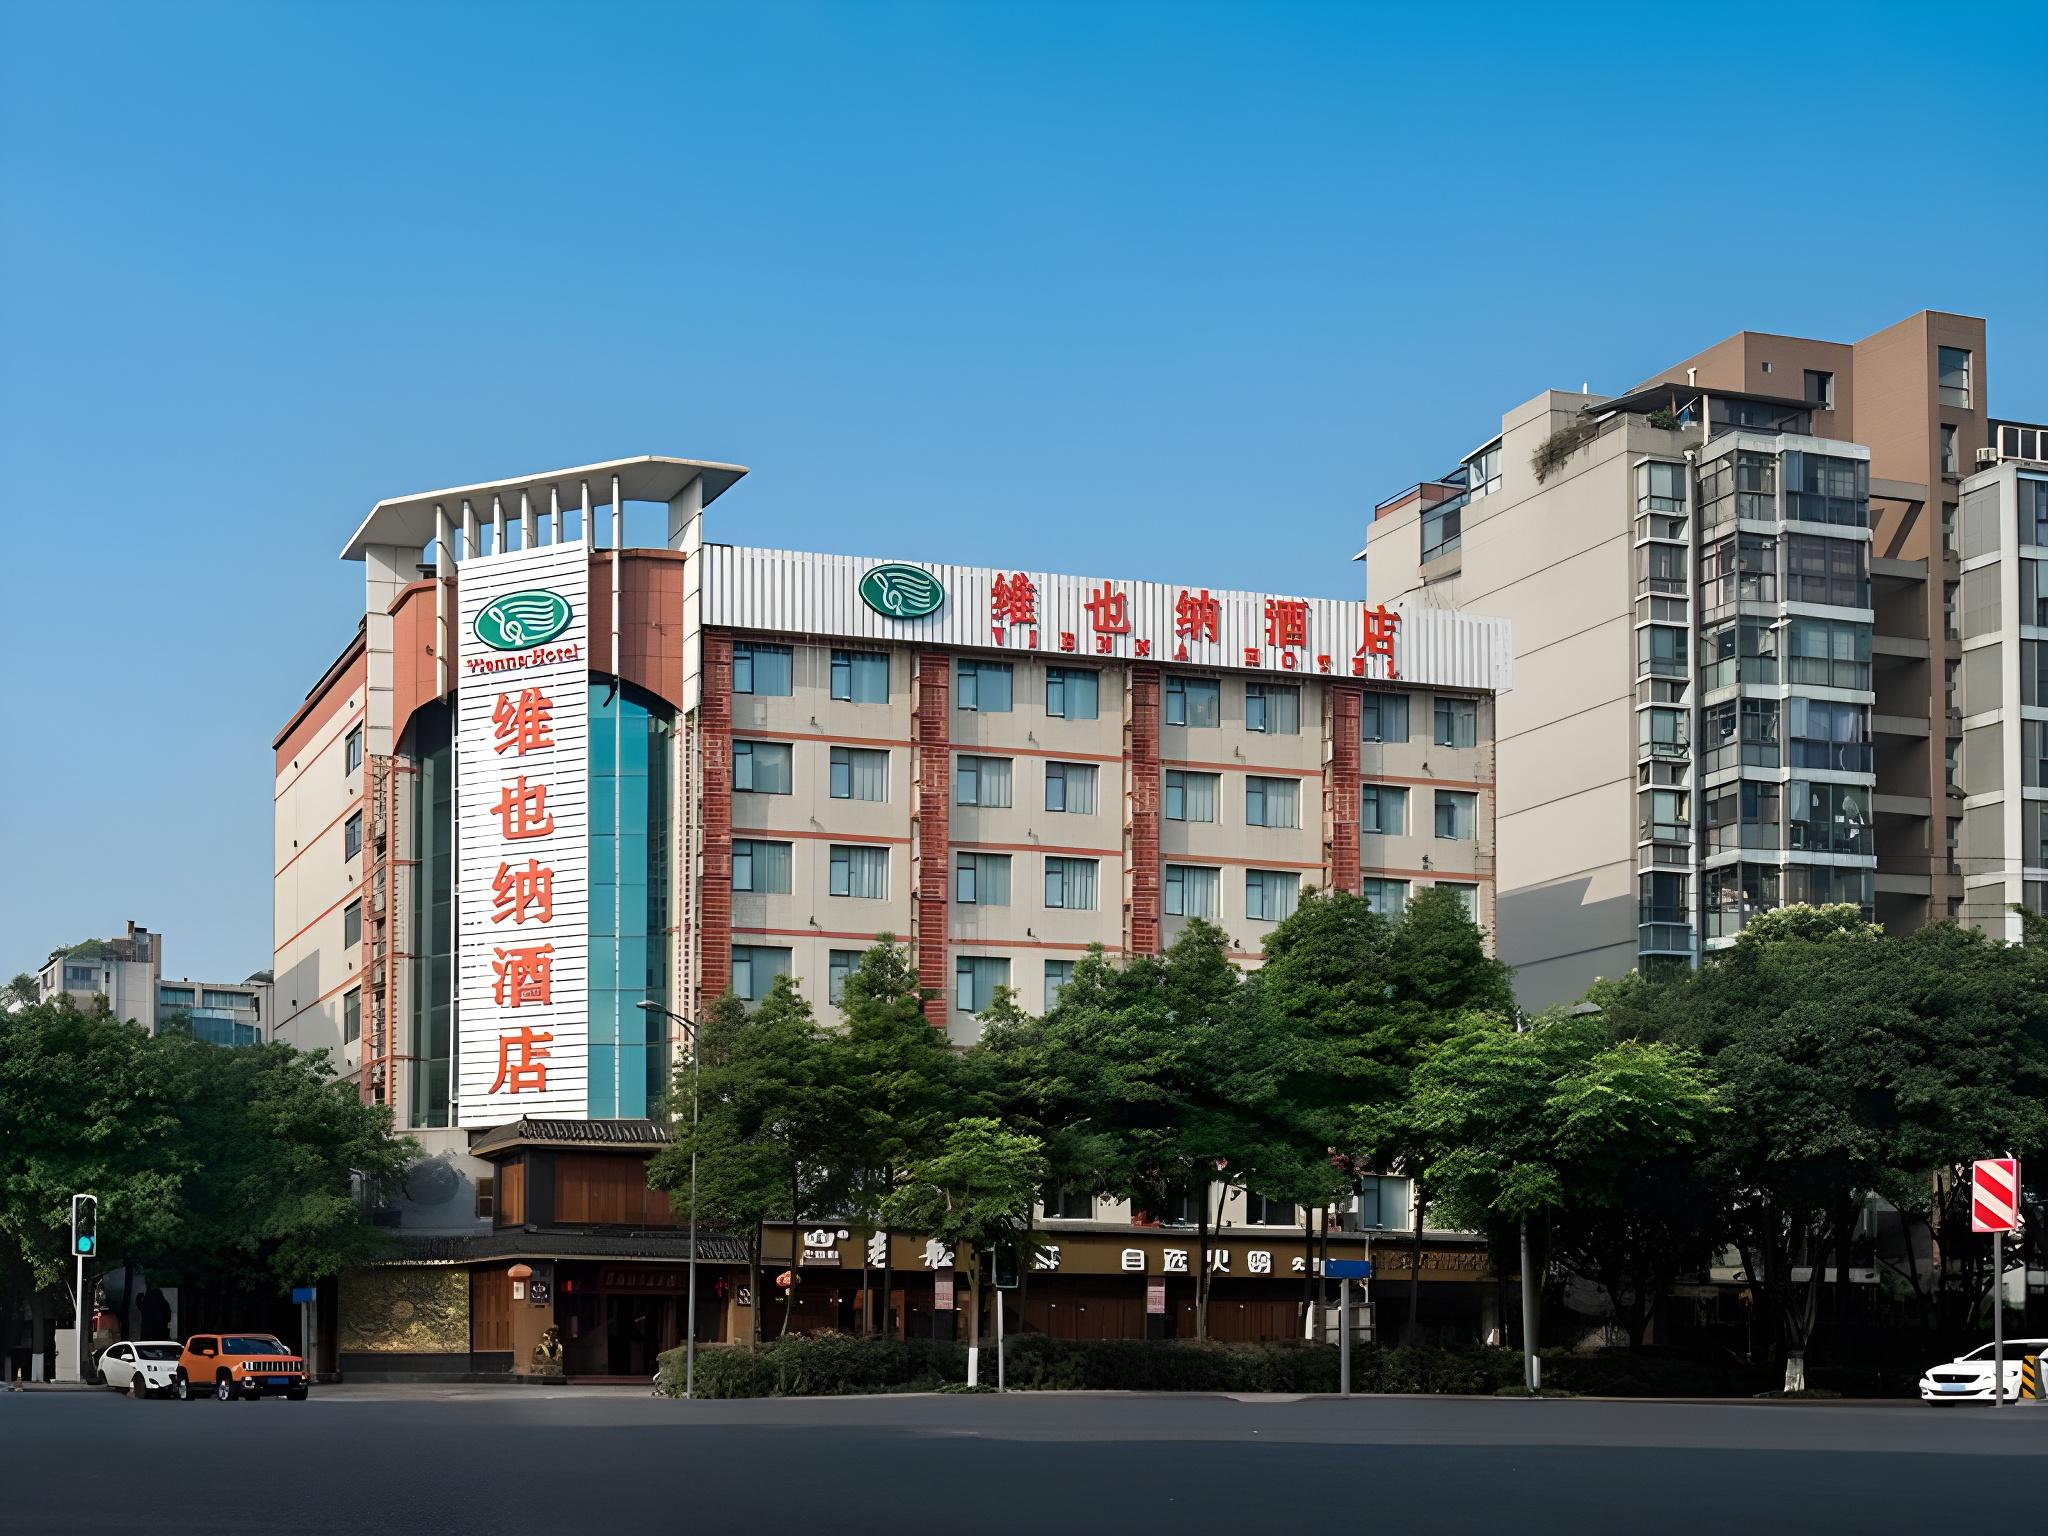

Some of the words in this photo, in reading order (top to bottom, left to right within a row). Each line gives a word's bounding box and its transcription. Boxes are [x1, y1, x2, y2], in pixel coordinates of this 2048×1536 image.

[991, 572, 1401, 658] 维也纳酒店
[488, 687, 556, 1095] 维也纳酒店
